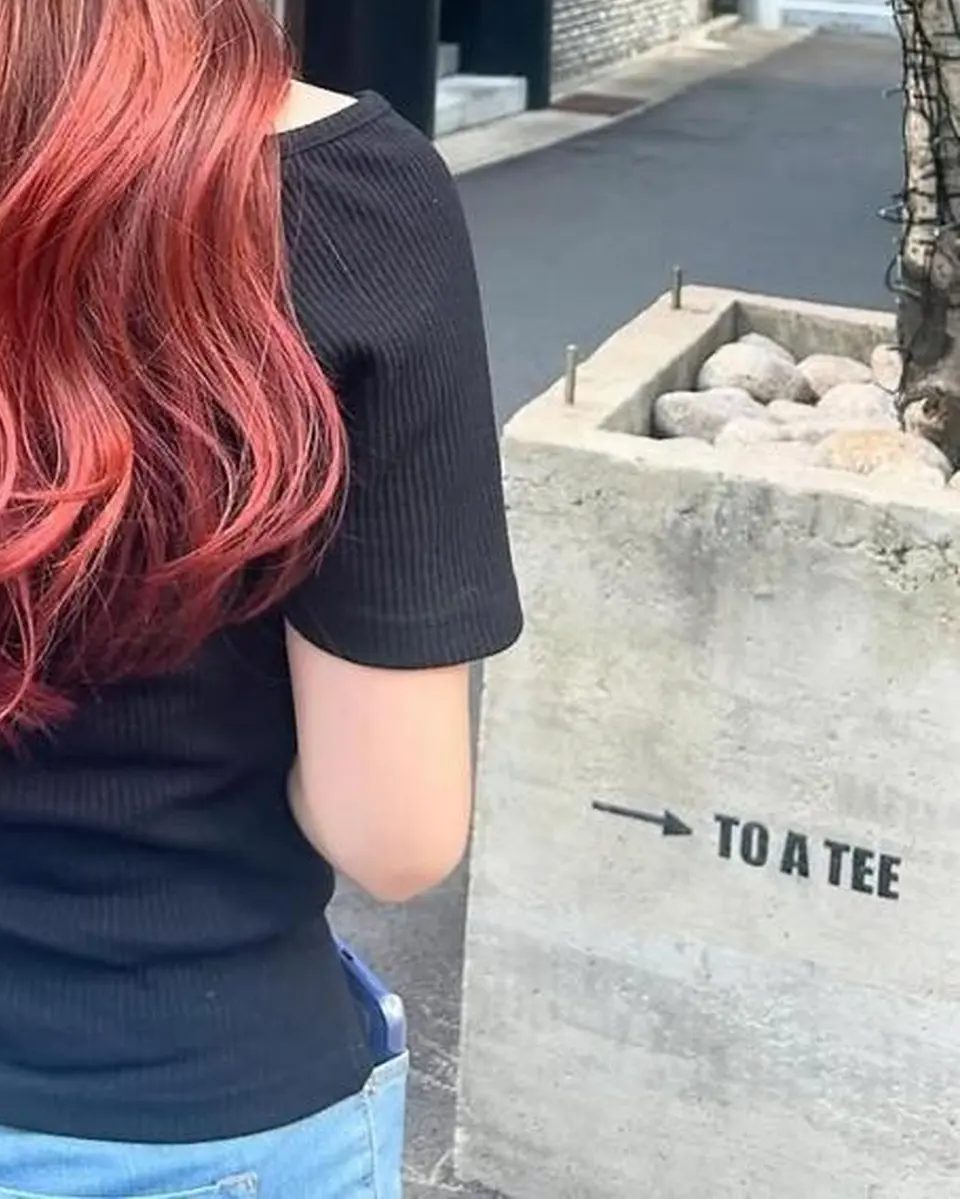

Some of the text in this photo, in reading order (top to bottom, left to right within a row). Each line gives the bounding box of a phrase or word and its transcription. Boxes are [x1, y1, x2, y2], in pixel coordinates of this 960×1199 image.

[714, 813, 901, 900] TO A TEE
